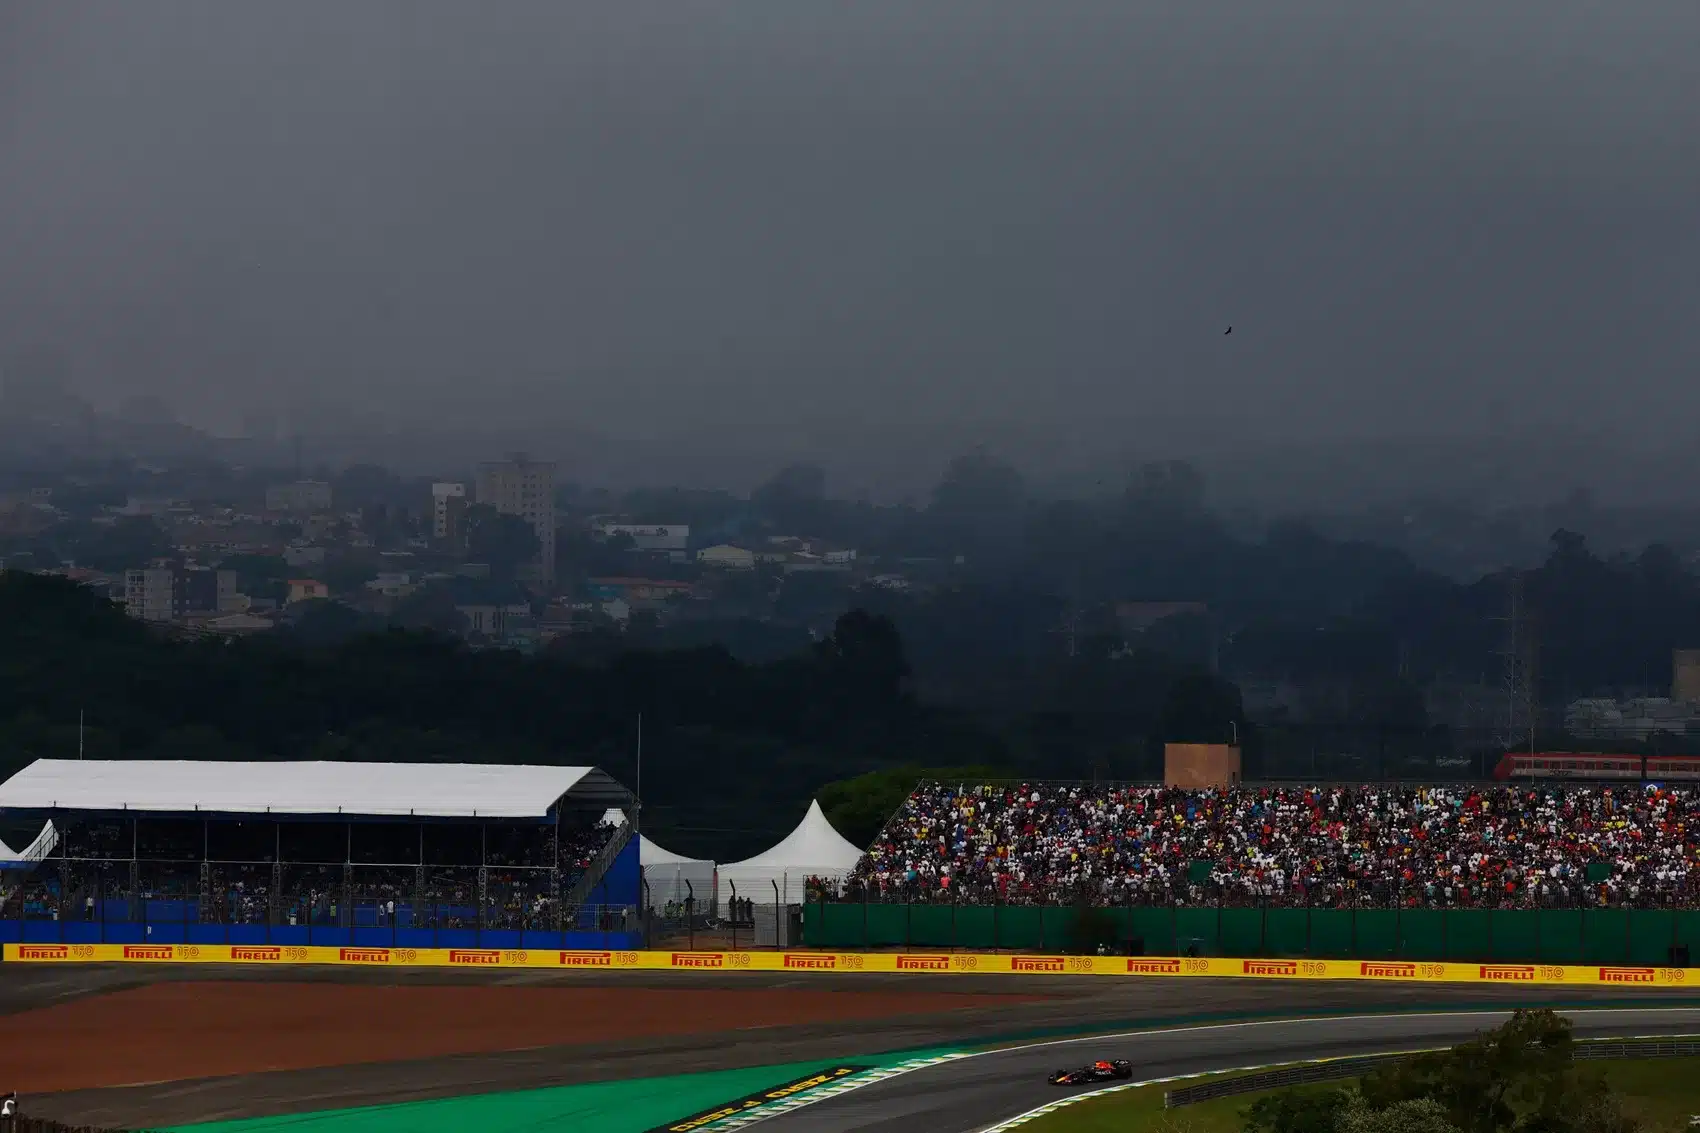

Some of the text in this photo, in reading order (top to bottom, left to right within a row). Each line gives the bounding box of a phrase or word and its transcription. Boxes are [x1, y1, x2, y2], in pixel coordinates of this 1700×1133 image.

[18, 946, 68, 958] PIRELLI
[123, 946, 172, 959] PIRELLI
[231, 948, 282, 960] PIRELLI
[340, 949, 389, 961] PIRELLI
[450, 951, 501, 963] PIRELLI
[560, 952, 612, 964] PIRELLI
[672, 954, 723, 967] PIRELLI
[784, 955, 836, 968] PIRELLI
[896, 956, 948, 968] PIRELLI
[1012, 958, 1064, 970] PIRELLI
[1128, 960, 1180, 972] PIRELLI
[1243, 960, 1296, 974] PIRELLI
[1360, 963, 1414, 976] PIRELLI
[1480, 966, 1535, 979] PIRELLI
[1599, 968, 1655, 982] PIRELLI
